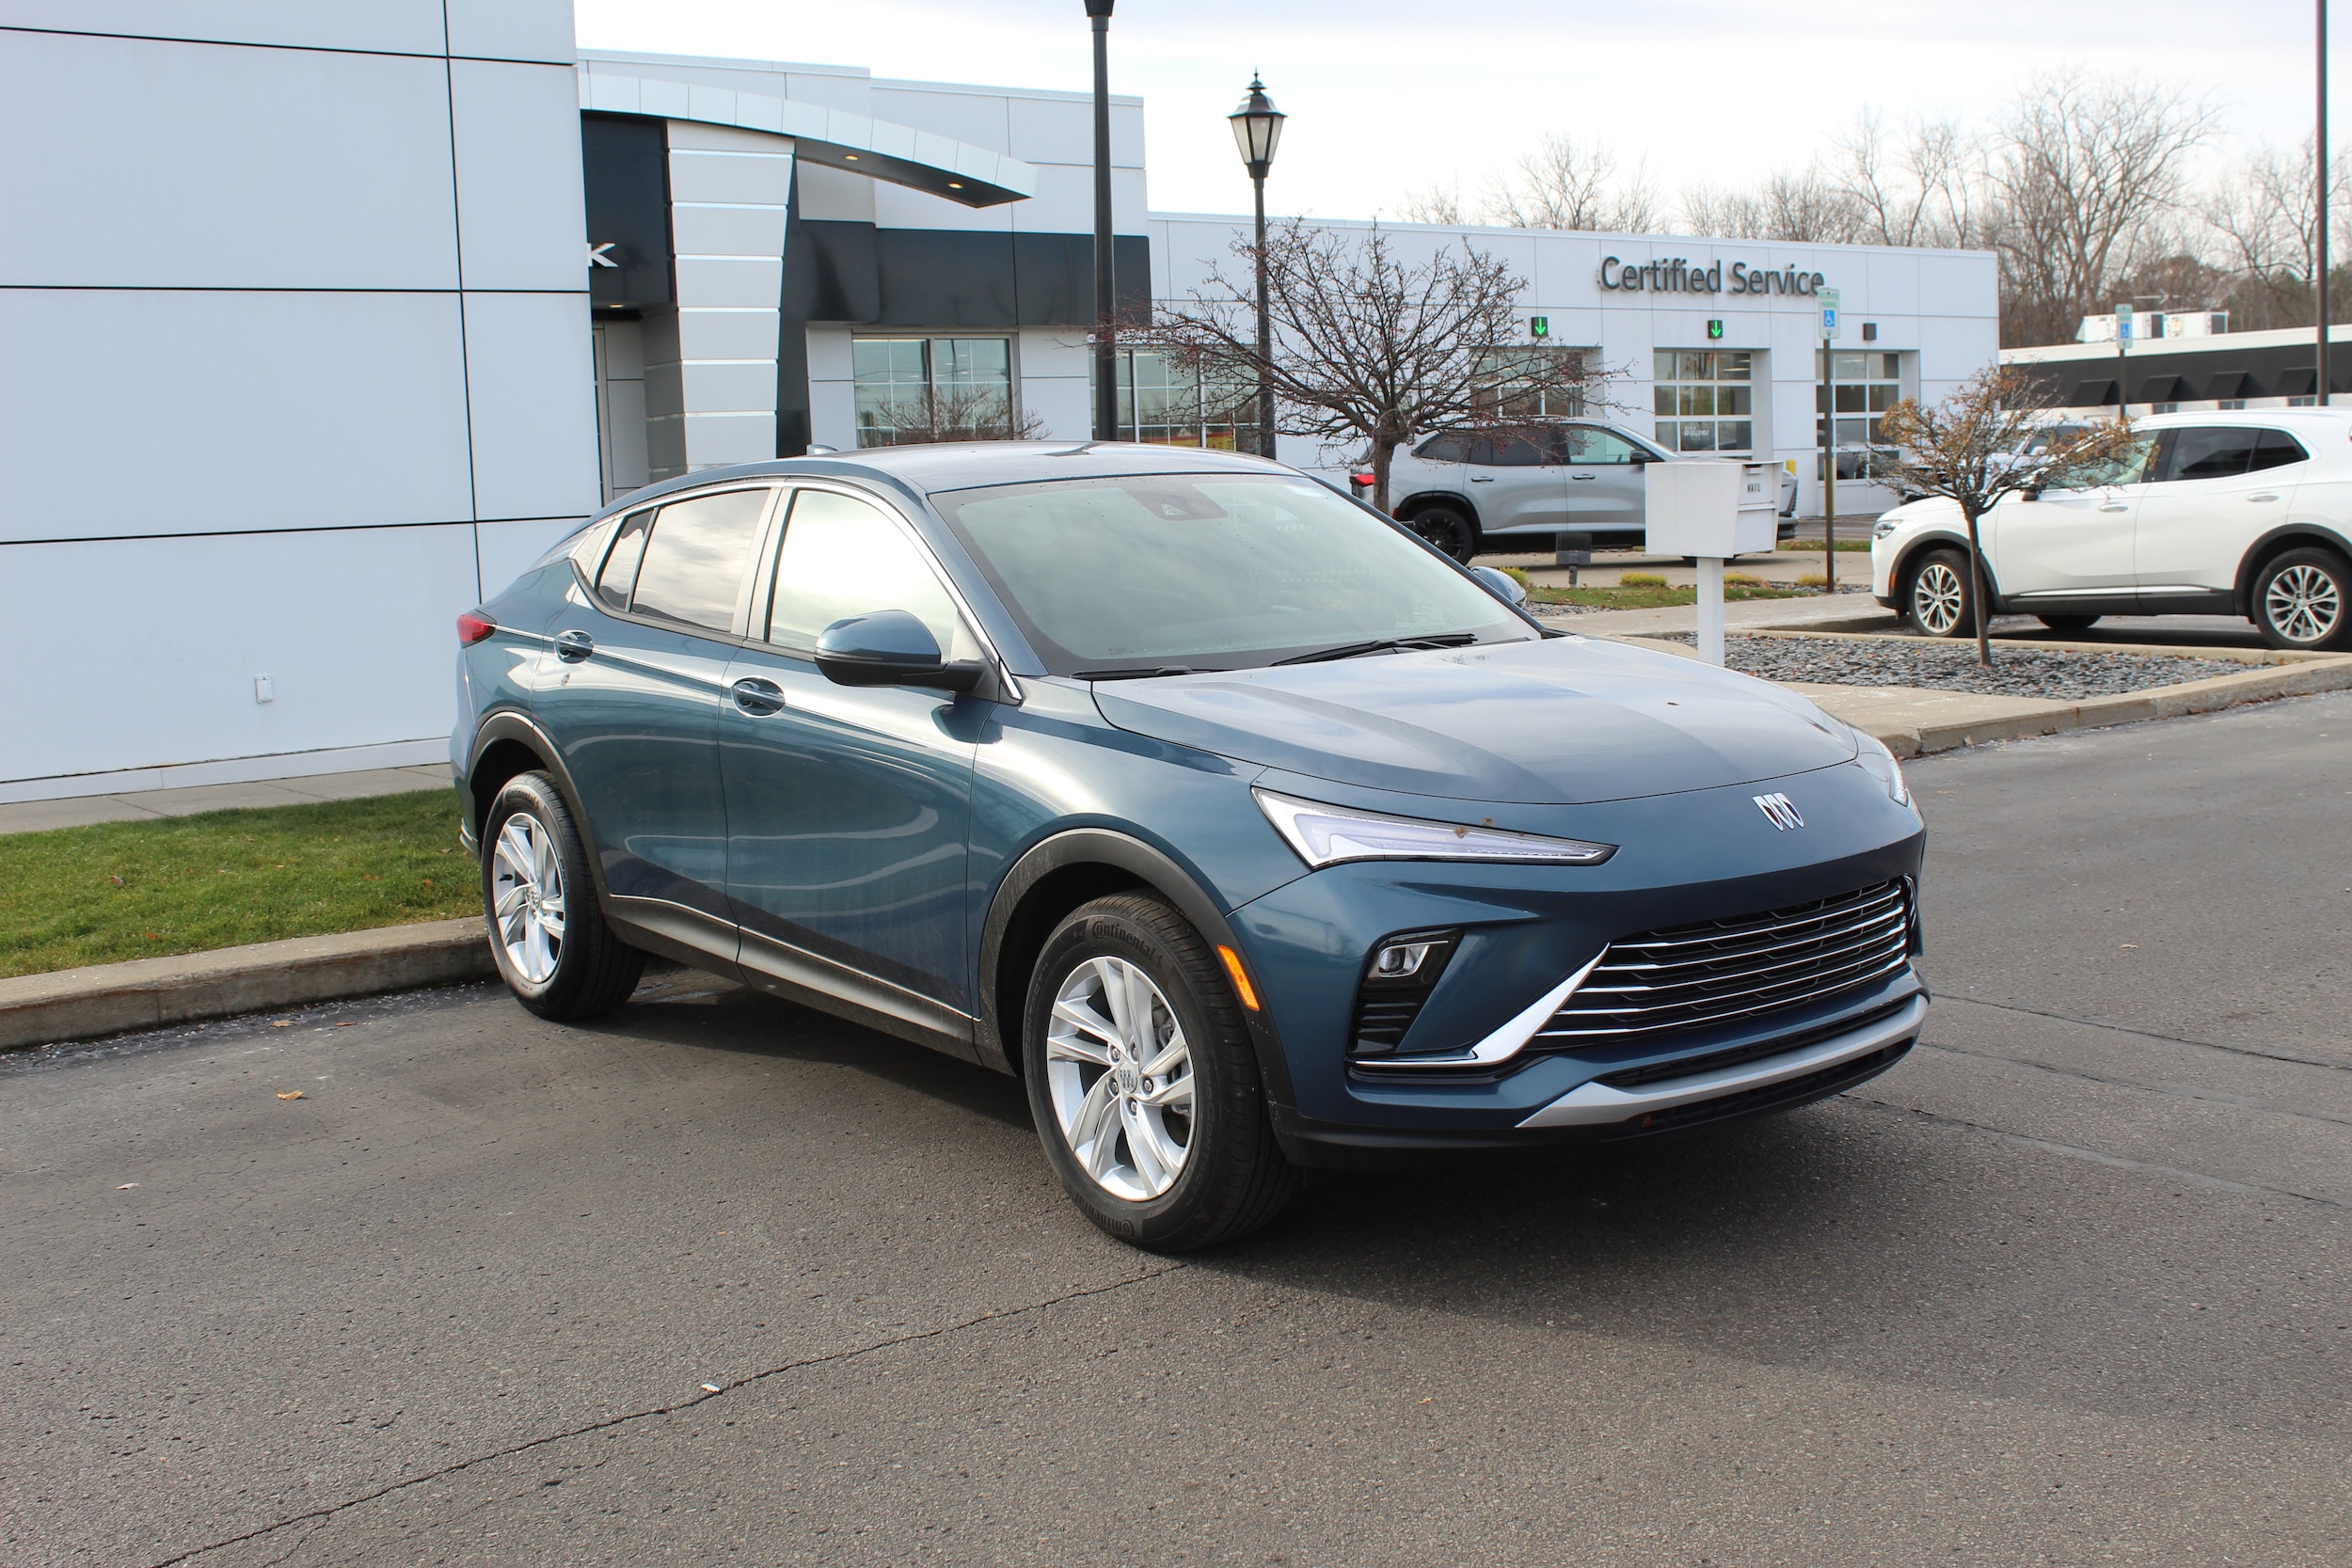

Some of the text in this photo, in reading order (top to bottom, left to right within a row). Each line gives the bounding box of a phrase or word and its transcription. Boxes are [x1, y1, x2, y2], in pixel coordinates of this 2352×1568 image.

[587, 243, 619, 267] K
[1600, 255, 1825, 296] Certified Service
[1683, 425, 1710, 437] Welcome
[506, 788, 536, 806] Continental
[1092, 921, 1156, 960] Continental
[1075, 1192, 1135, 1237] Continental
